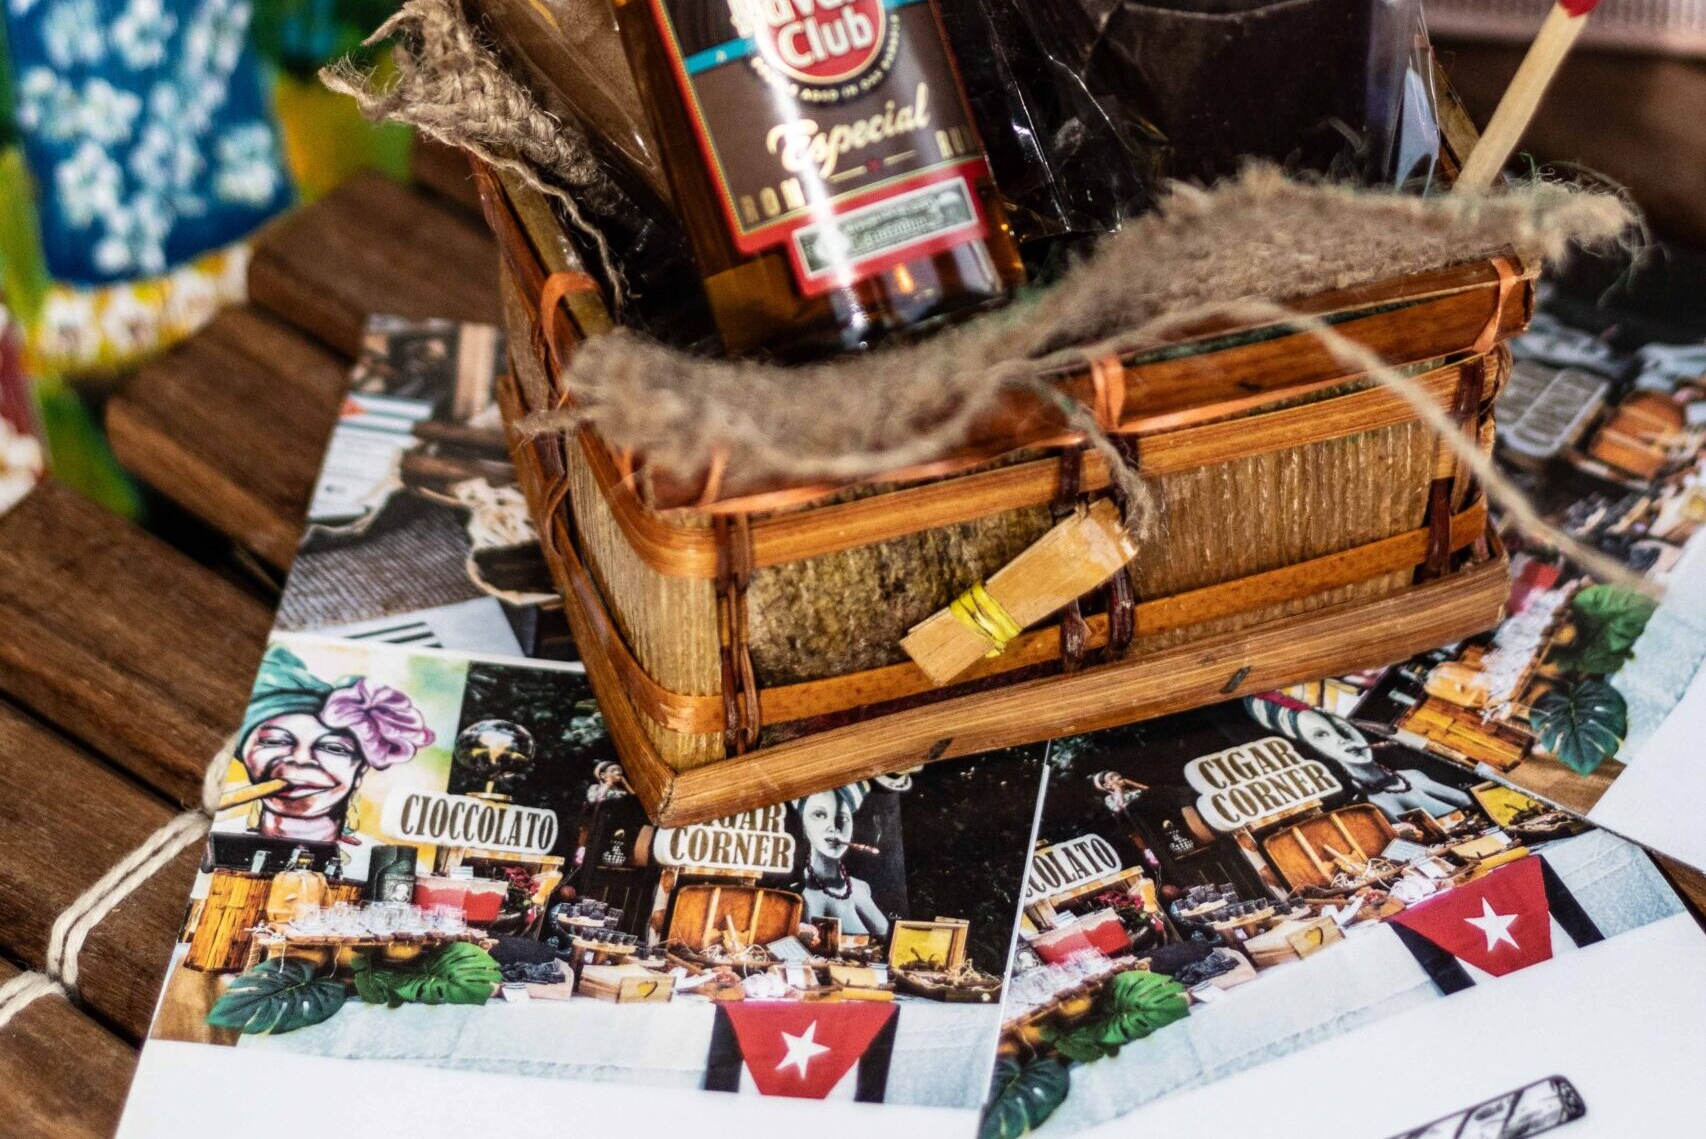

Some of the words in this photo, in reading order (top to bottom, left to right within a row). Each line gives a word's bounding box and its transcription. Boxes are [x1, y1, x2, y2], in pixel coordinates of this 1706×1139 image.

[777, 7, 875, 69] Club
[766, 81, 931, 179] Especial
[1198, 740, 1300, 789] CIGAR
[1211, 764, 1337, 823] CORNER
[400, 793, 554, 850] CIOCCOLATO
[669, 827, 792, 868] CORNER
